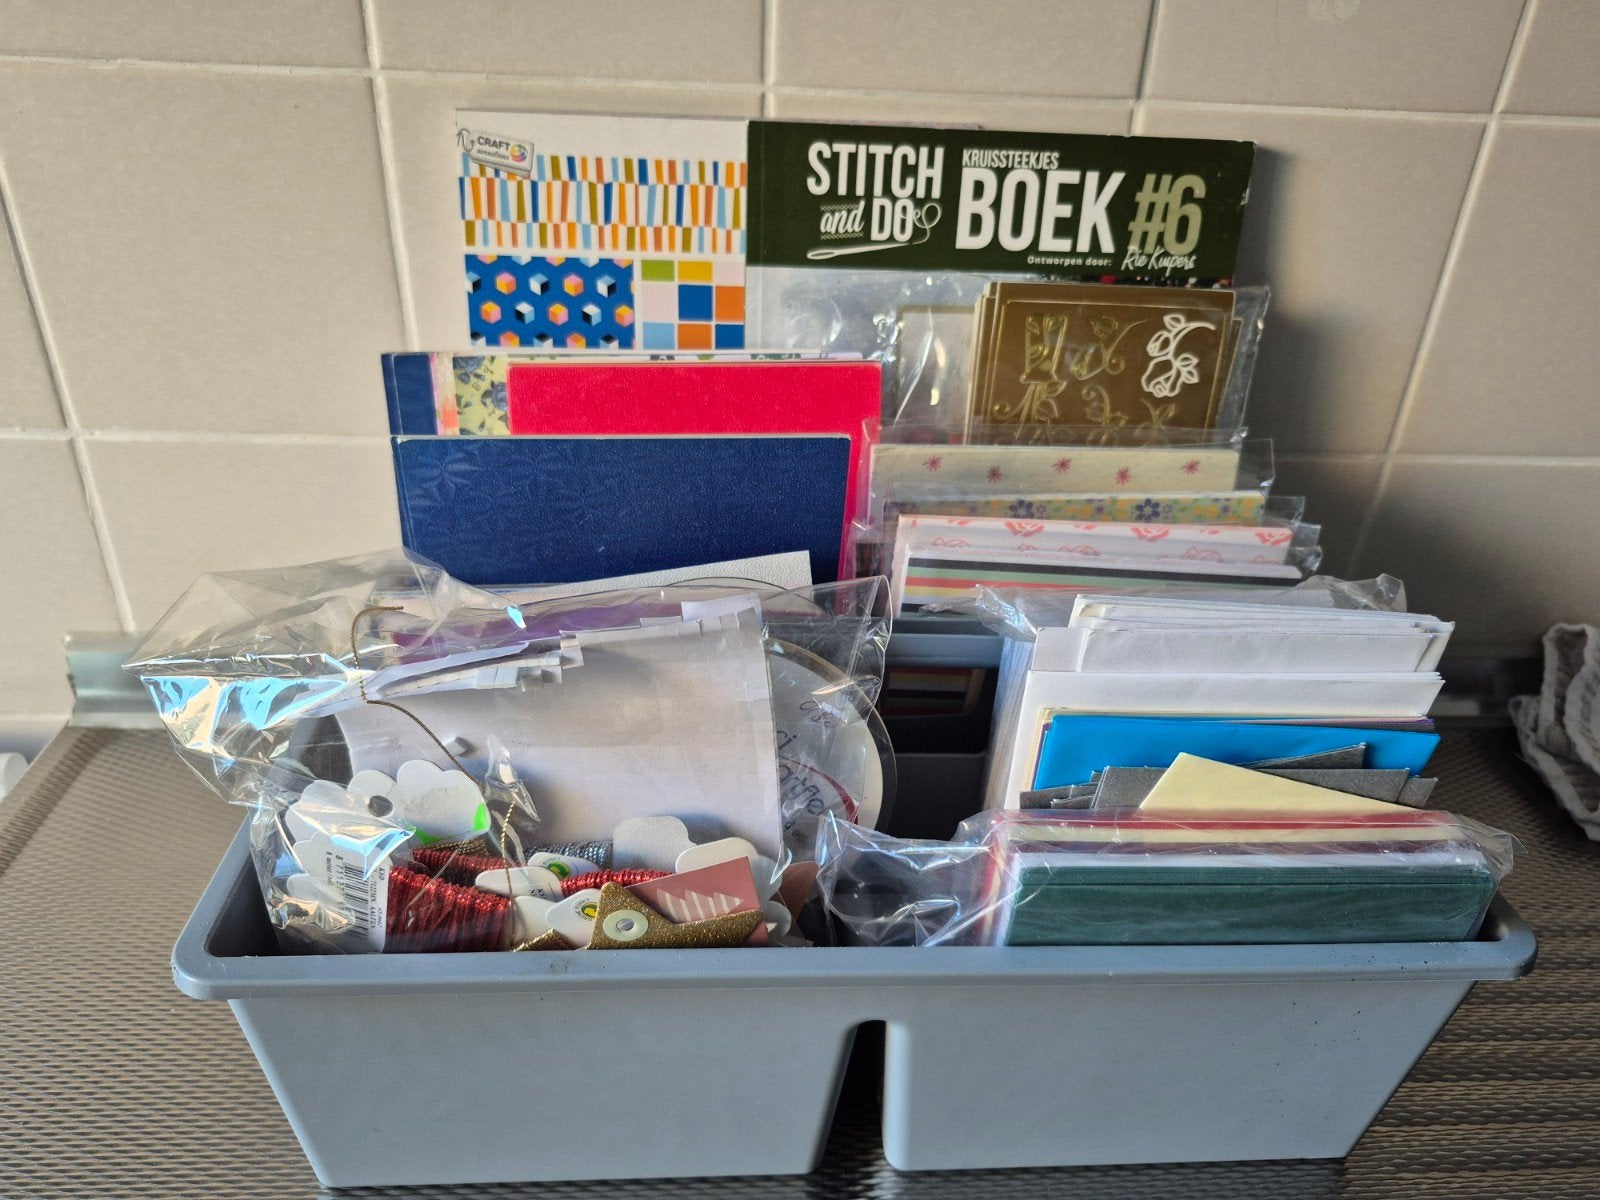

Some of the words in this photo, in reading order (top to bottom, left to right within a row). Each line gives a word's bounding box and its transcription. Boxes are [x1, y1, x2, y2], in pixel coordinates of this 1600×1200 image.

[477, 136, 510, 151] CRAFT
[962, 149, 1060, 170] KRUISSTEEKJES
[806, 141, 946, 199] STITCH
[819, 199, 866, 235] and
[870, 197, 915, 242] DO
[955, 167, 1127, 254] BOEK
[1127, 173, 1207, 256] #6
[1026, 255, 1083, 267] Ontworpen
[1085, 256, 1113, 267] door:
[1121, 246, 1147, 271] Rie
[1147, 245, 1198, 278] Kuipers
